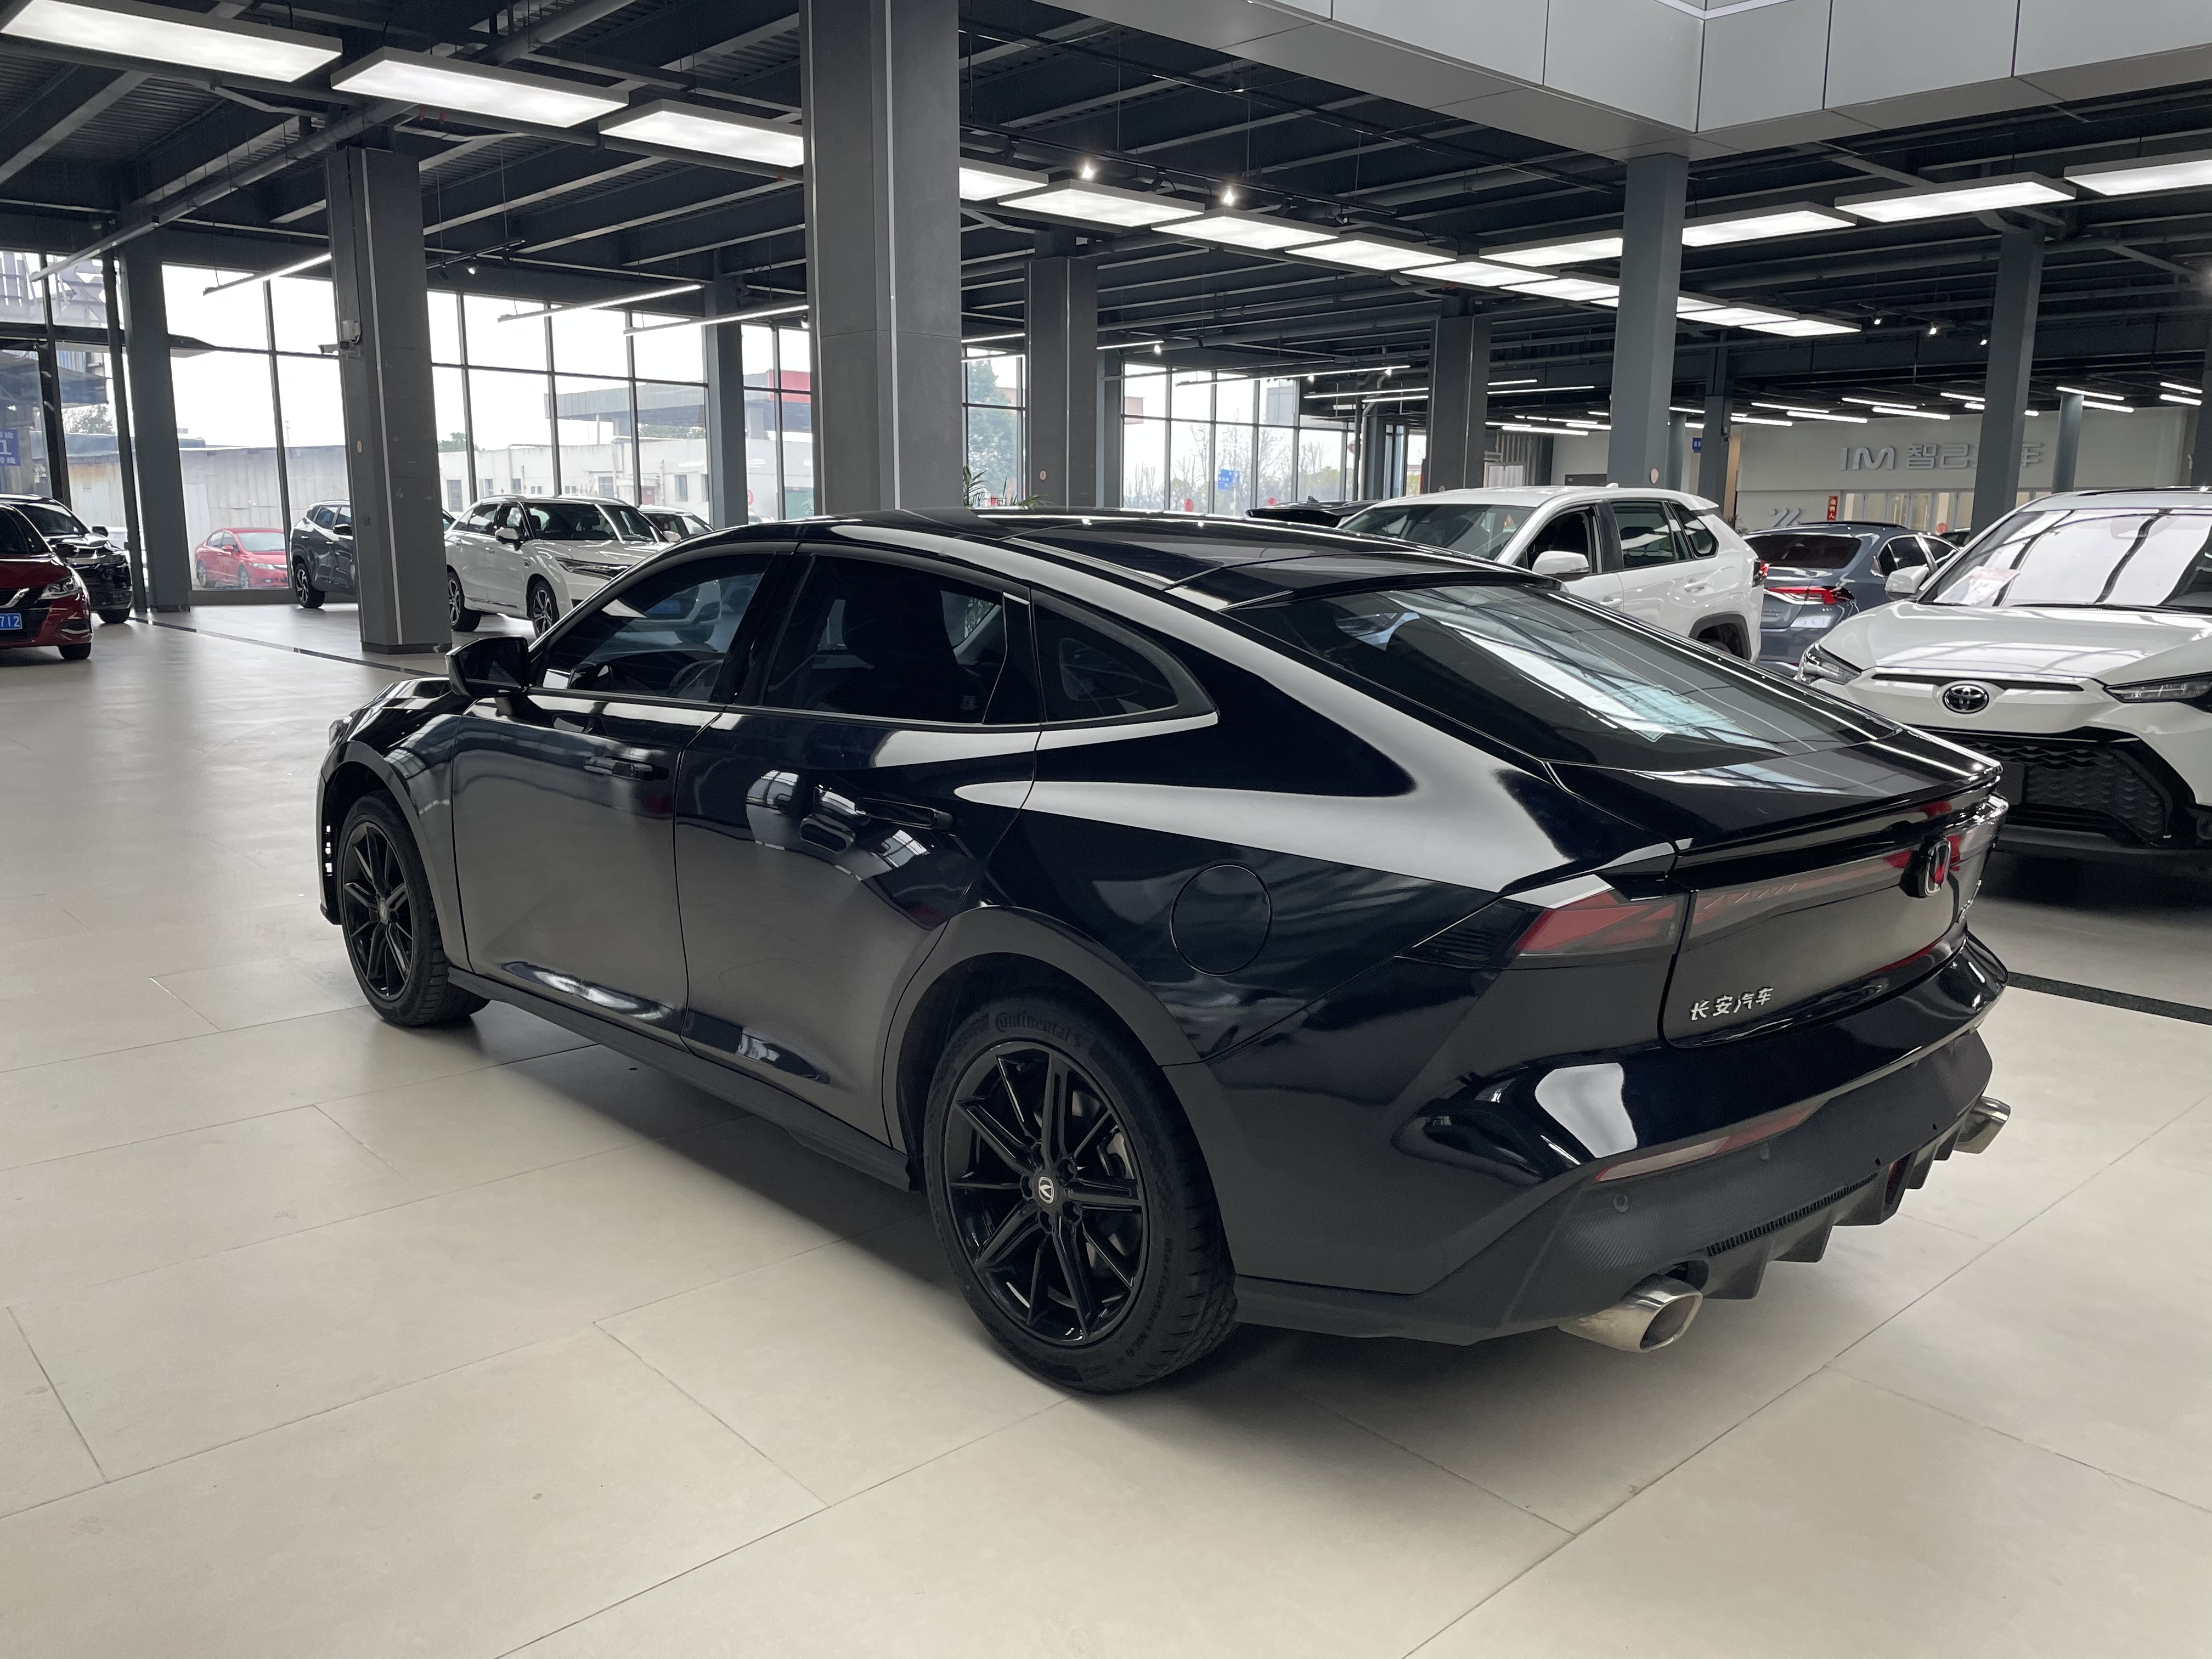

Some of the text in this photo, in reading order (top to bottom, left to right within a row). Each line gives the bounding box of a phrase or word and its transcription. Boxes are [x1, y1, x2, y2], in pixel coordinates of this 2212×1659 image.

[1839, 443, 2041, 470] IM 智己车
[0, 616, 21, 628] 712
[1690, 988, 1774, 1021] 长安汽车
[995, 1011, 1071, 1042] Continental
